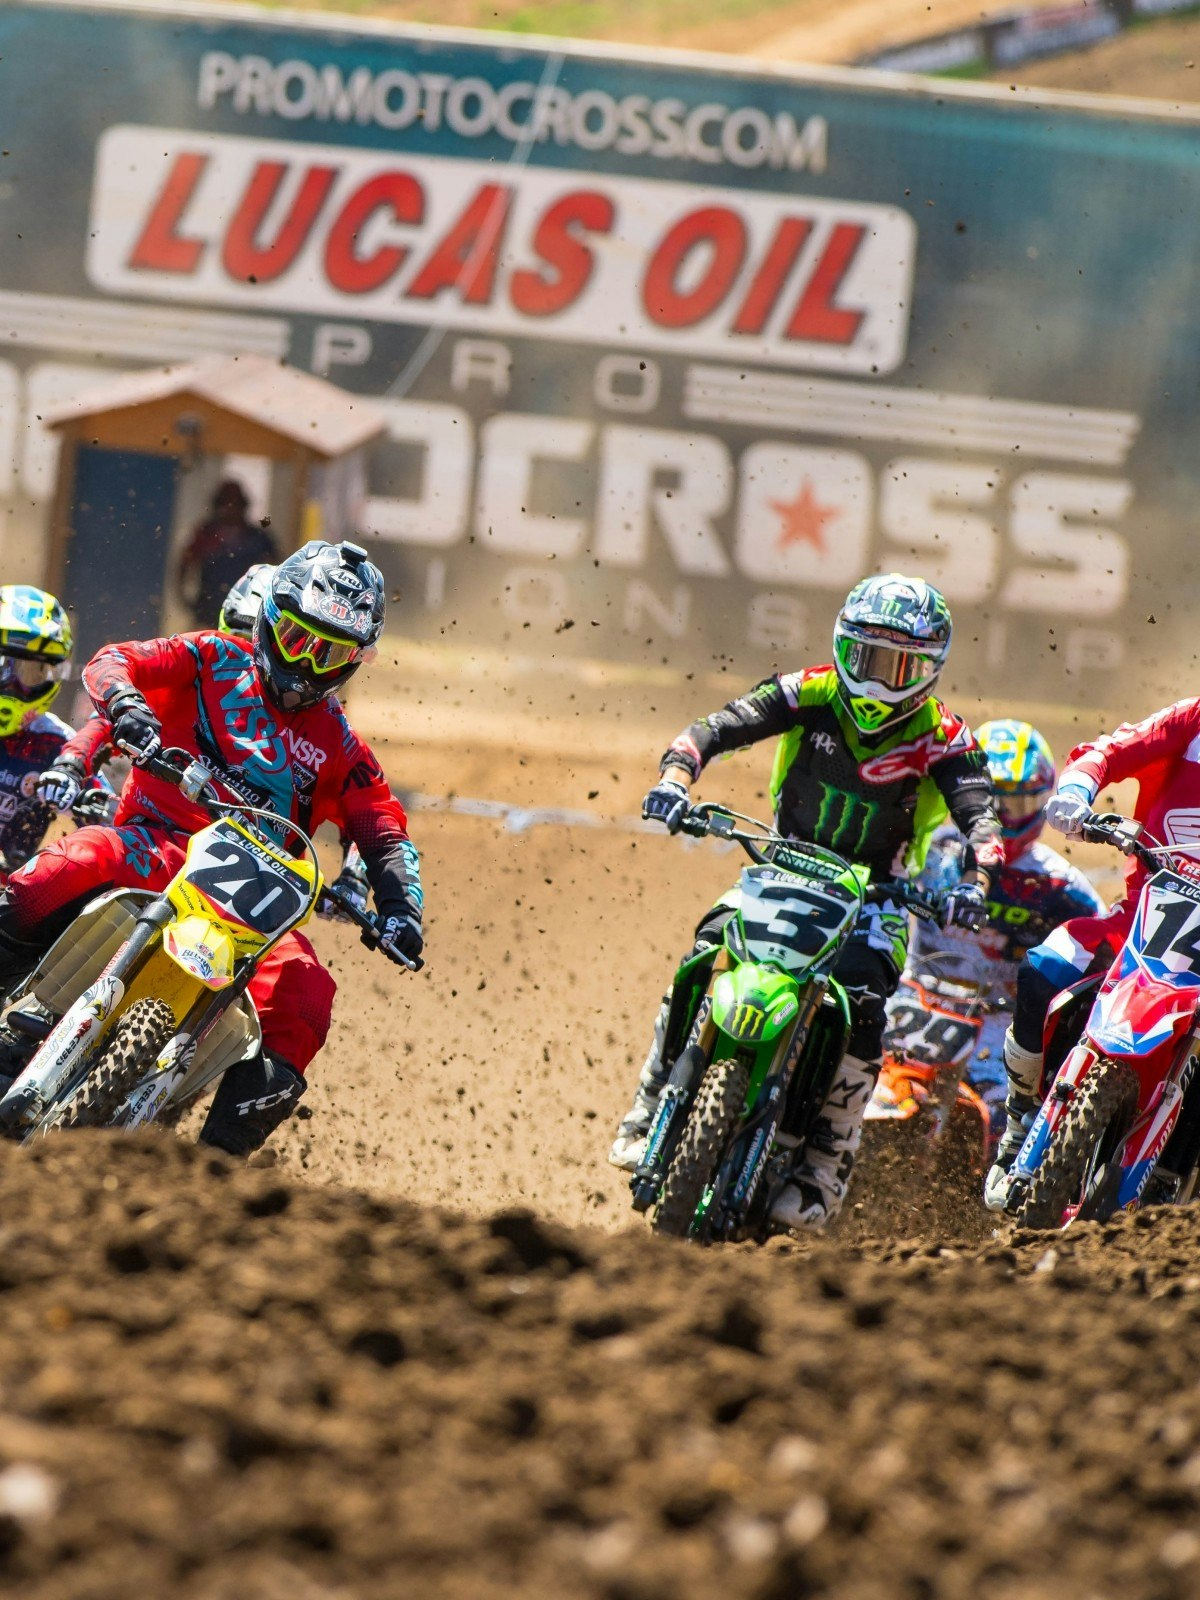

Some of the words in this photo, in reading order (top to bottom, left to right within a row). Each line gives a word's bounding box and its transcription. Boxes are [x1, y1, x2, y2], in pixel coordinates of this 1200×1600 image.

[127, 148, 618, 320] LUCAS
[642, 202, 870, 346] OIL
[311, 320, 661, 415] PRO
[184, 841, 302, 935] 20
[238, 839, 273, 864] LUCAS
[271, 859, 290, 877] OIL
[744, 886, 848, 957] 3
[235, 1083, 296, 1116] TCX
[1135, 1117, 1175, 1199] DUNLOP
